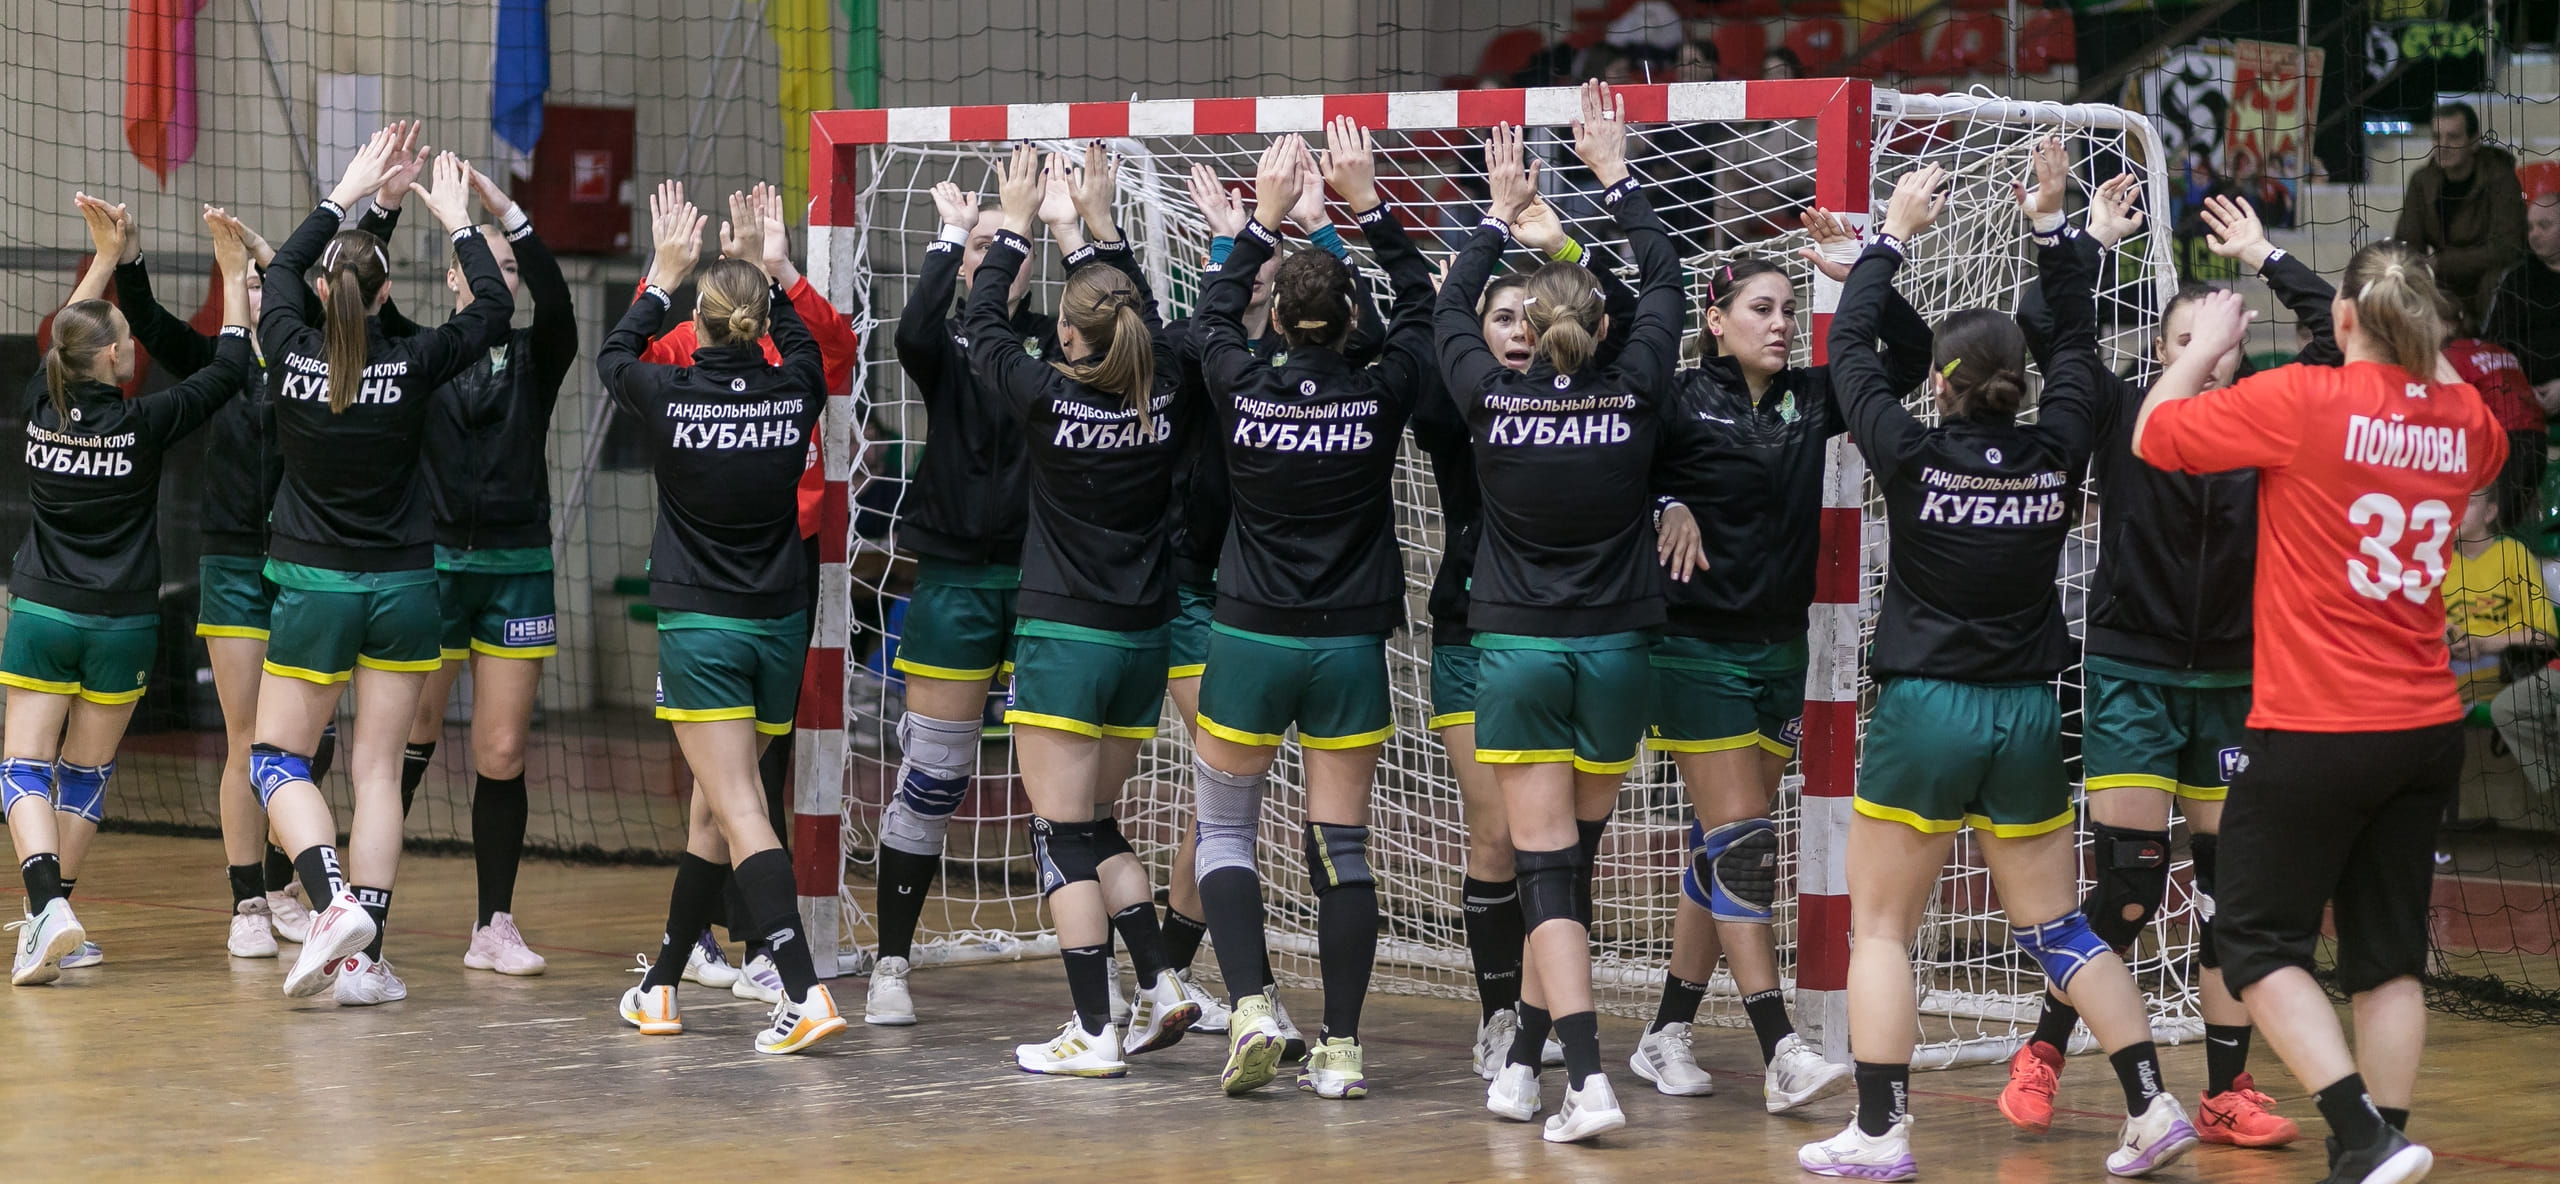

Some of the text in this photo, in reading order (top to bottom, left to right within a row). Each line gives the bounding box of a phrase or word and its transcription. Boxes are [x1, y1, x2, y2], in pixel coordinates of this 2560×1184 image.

[1357, 212, 1382, 224] Kem
[374, 362, 408, 377] КЛУБ
[281, 372, 402, 403] КУБНЬ
[667, 399, 803, 421] ГАНДБОЛЬНЫЙ КЛУБ
[1052, 400, 1151, 420] ГАНДБОЛЬНЫ
[1234, 395, 1378, 419] ГАНДБОЛЬНЫЙ КЛУБ
[1484, 394, 1636, 414] ГАНДБОЛЬНЫЙ КЛУБ
[26, 421, 136, 448] АНДБОЛЬНЫЙ КЛУБ
[672, 420, 800, 449] КУБАНЬ
[1054, 413, 1171, 449] КУБАНЬ
[1233, 418, 1373, 452] КУБАНЬ
[1488, 413, 1631, 445] КУБАНЬ
[2344, 413, 2467, 473] ПОЙЛОВА
[25, 441, 133, 476] КУБАНЬ
[1920, 467, 2039, 491] ГАНДБОЛЬНЫЙ
[1919, 491, 2065, 525] КУБАНЬ
[2347, 492, 2452, 605] 33
[1484, 970, 1516, 981] Kemp
[1745, 989, 1780, 1005] Kemp
[2137, 1060, 2160, 1099] Kempa
[1888, 1081, 1908, 1123] Kempa
